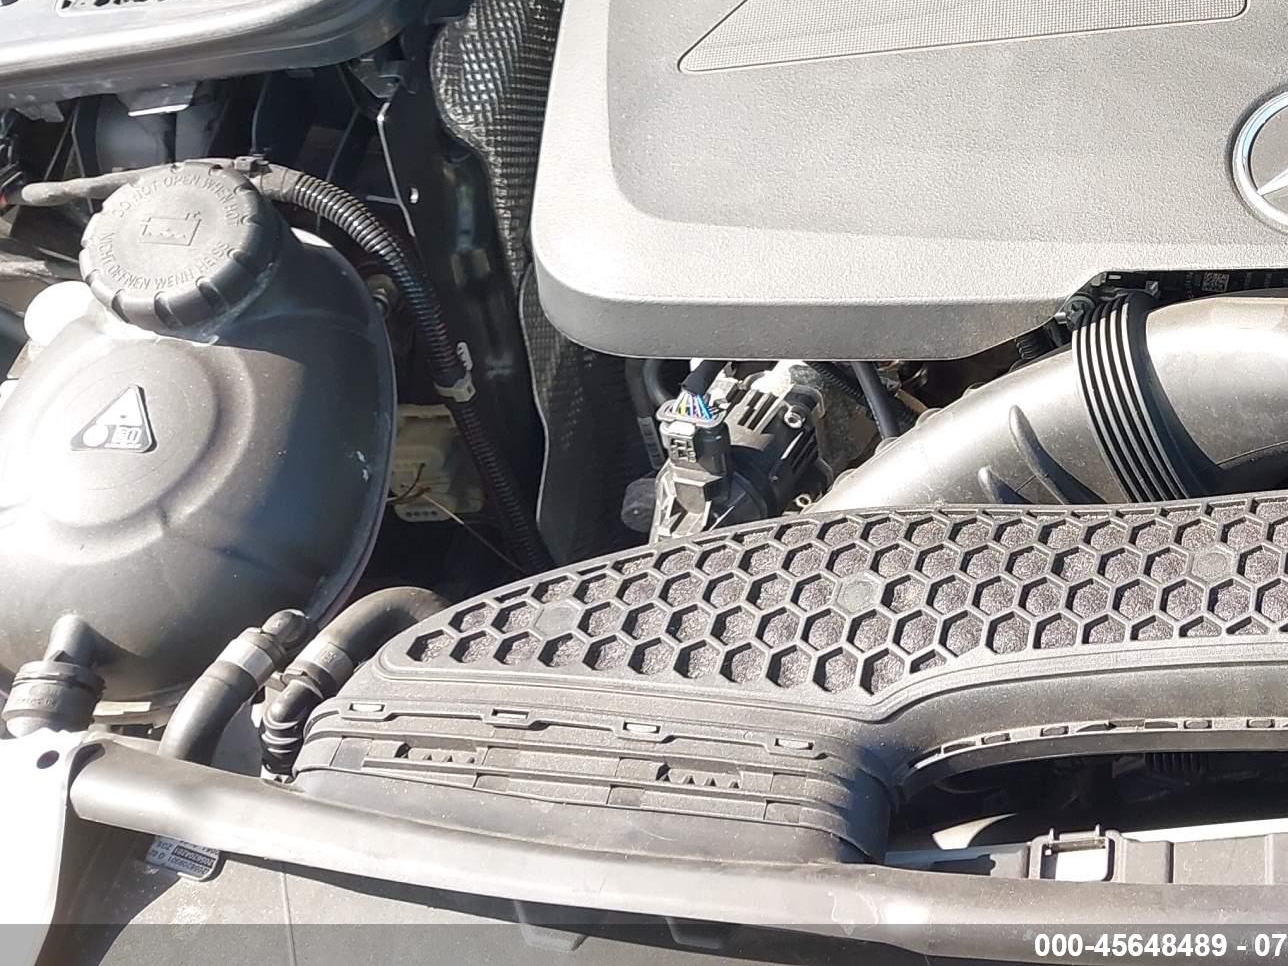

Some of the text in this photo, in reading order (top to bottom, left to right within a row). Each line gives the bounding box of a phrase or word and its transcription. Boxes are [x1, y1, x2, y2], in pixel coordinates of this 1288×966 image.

[163, 175, 201, 187] OPEN
[202, 176, 235, 205] WHEN
[154, 268, 195, 290] WENN
